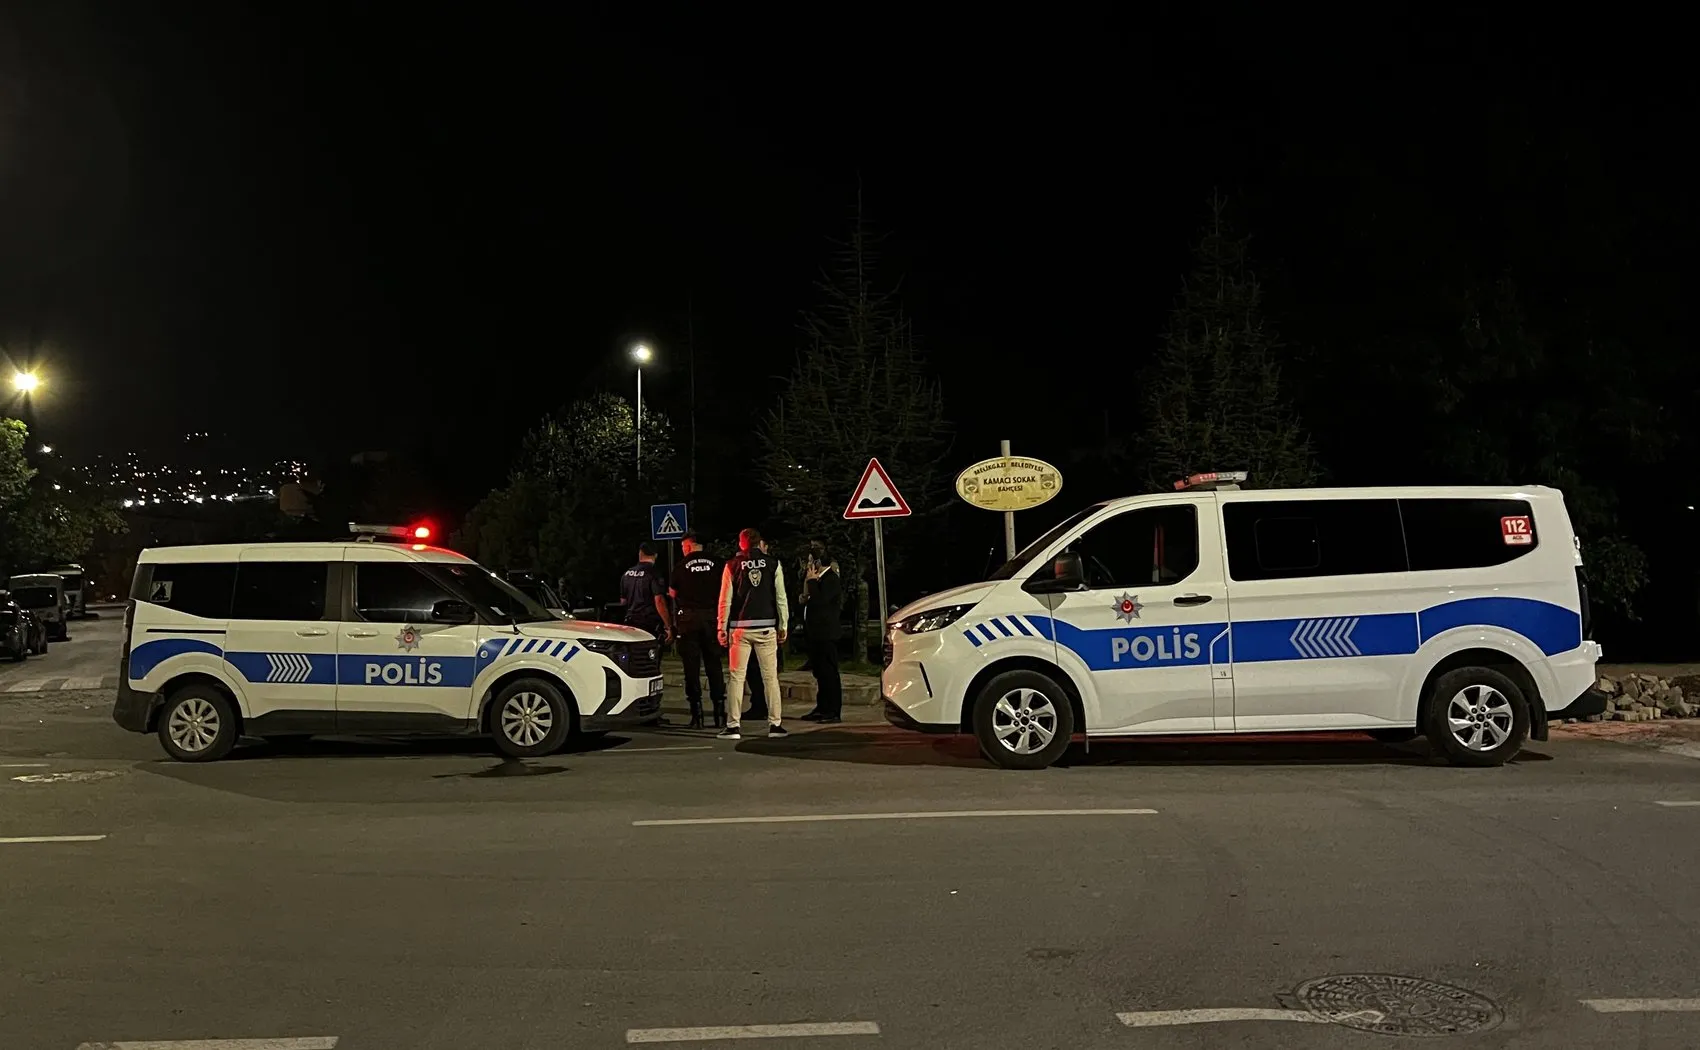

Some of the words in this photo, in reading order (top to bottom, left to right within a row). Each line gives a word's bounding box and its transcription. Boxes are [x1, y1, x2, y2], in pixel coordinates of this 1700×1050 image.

[1505, 520, 1527, 533] 112
[1111, 627, 1201, 662] POLİS
[365, 657, 442, 684] POLİS
